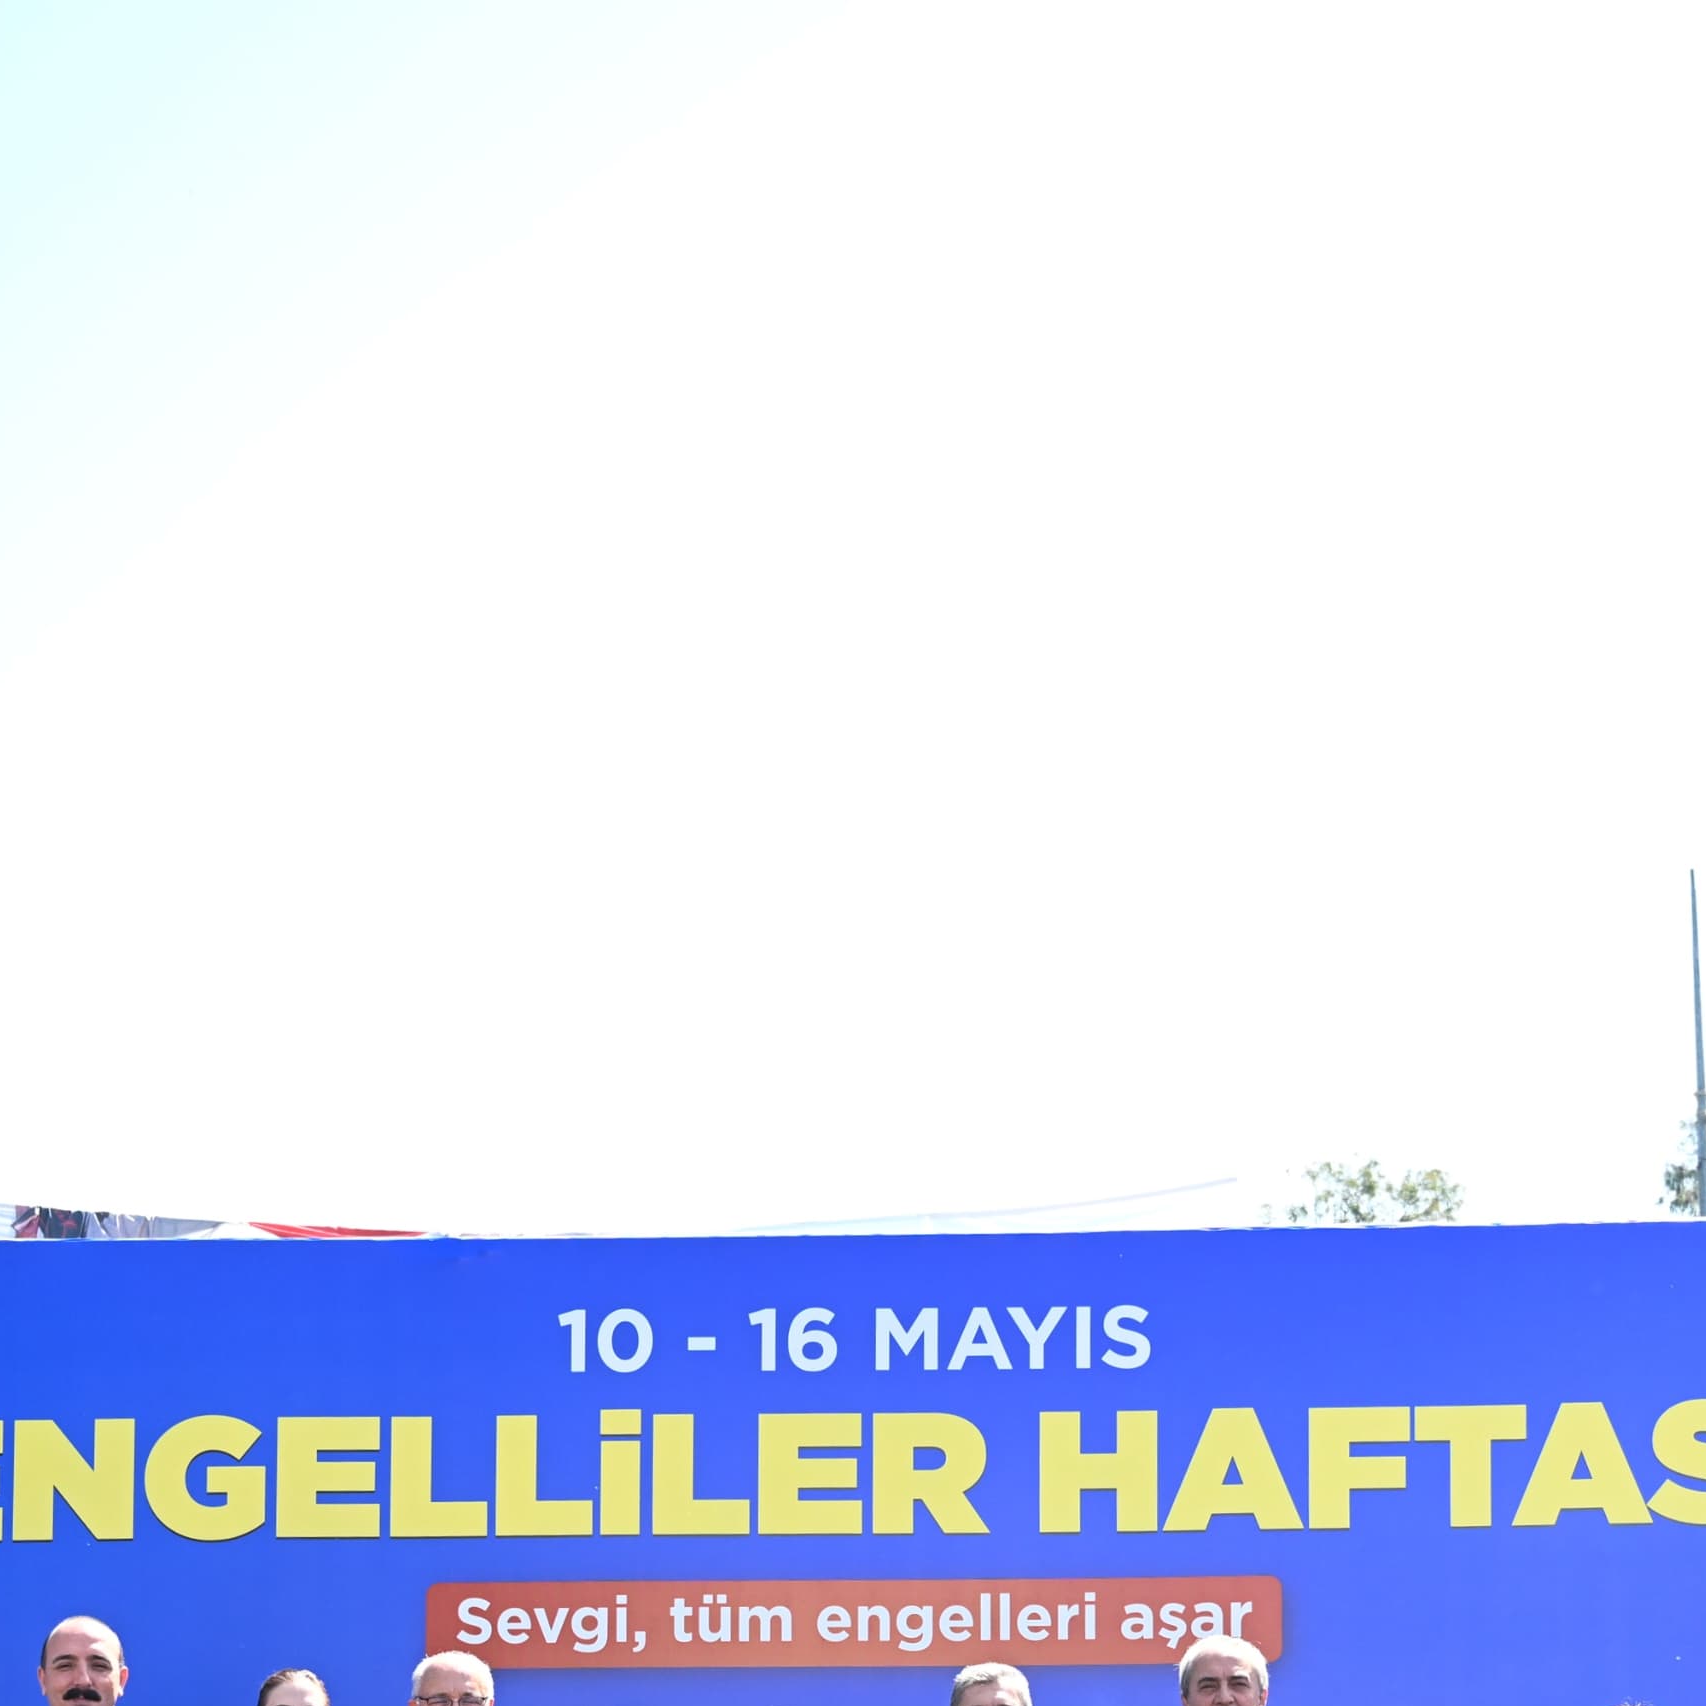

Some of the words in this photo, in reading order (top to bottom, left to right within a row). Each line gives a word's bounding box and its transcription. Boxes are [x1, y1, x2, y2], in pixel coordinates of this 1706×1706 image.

[558, 1308, 653, 1373] 10
[748, 1307, 838, 1372] 16
[875, 1304, 1151, 1371] MAYIS
[455, 1594, 647, 1658] Sevgi,
[669, 1593, 793, 1643] tüm
[816, 1590, 1097, 1656] engelleri
[1120, 1600, 1253, 1649] aşar
